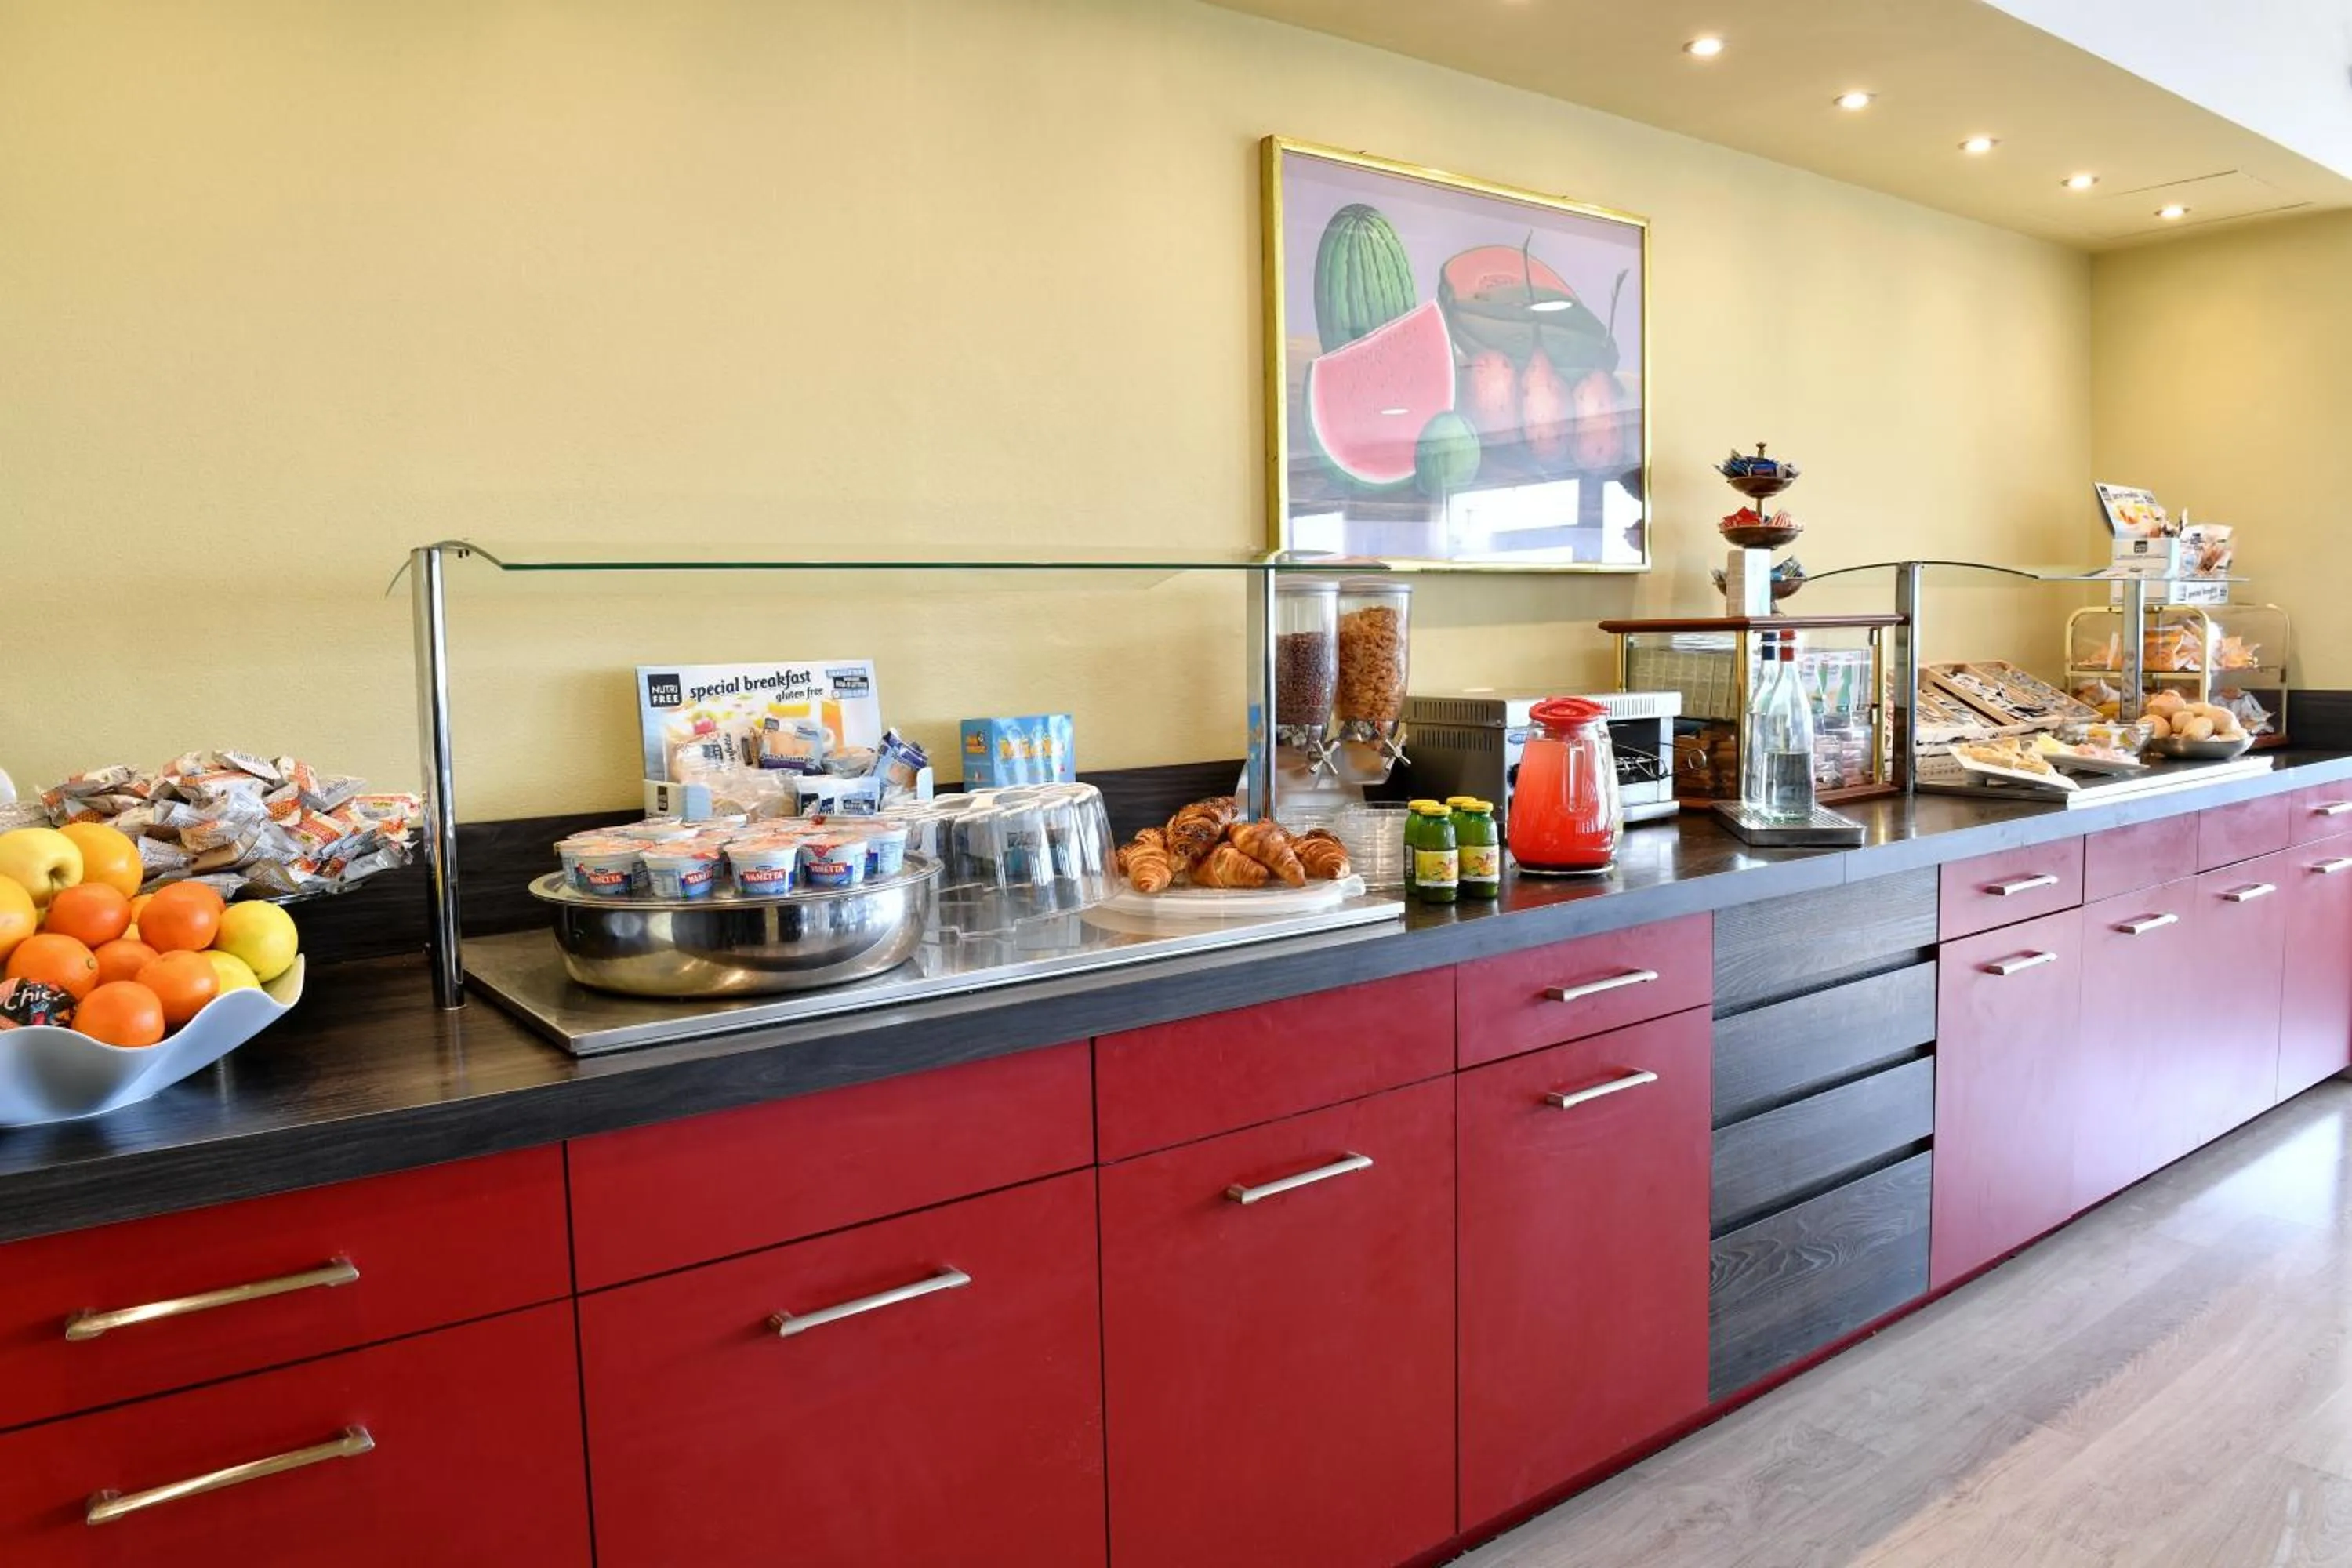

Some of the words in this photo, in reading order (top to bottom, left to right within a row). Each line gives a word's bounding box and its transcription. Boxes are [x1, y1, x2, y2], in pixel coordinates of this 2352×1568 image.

[652, 684, 678, 694] NUTRI
[690, 677, 739, 702] special
[744, 669, 811, 690] breakfast
[652, 694, 680, 704] FREE
[776, 688, 804, 702] gluten
[807, 686, 823, 699] free
